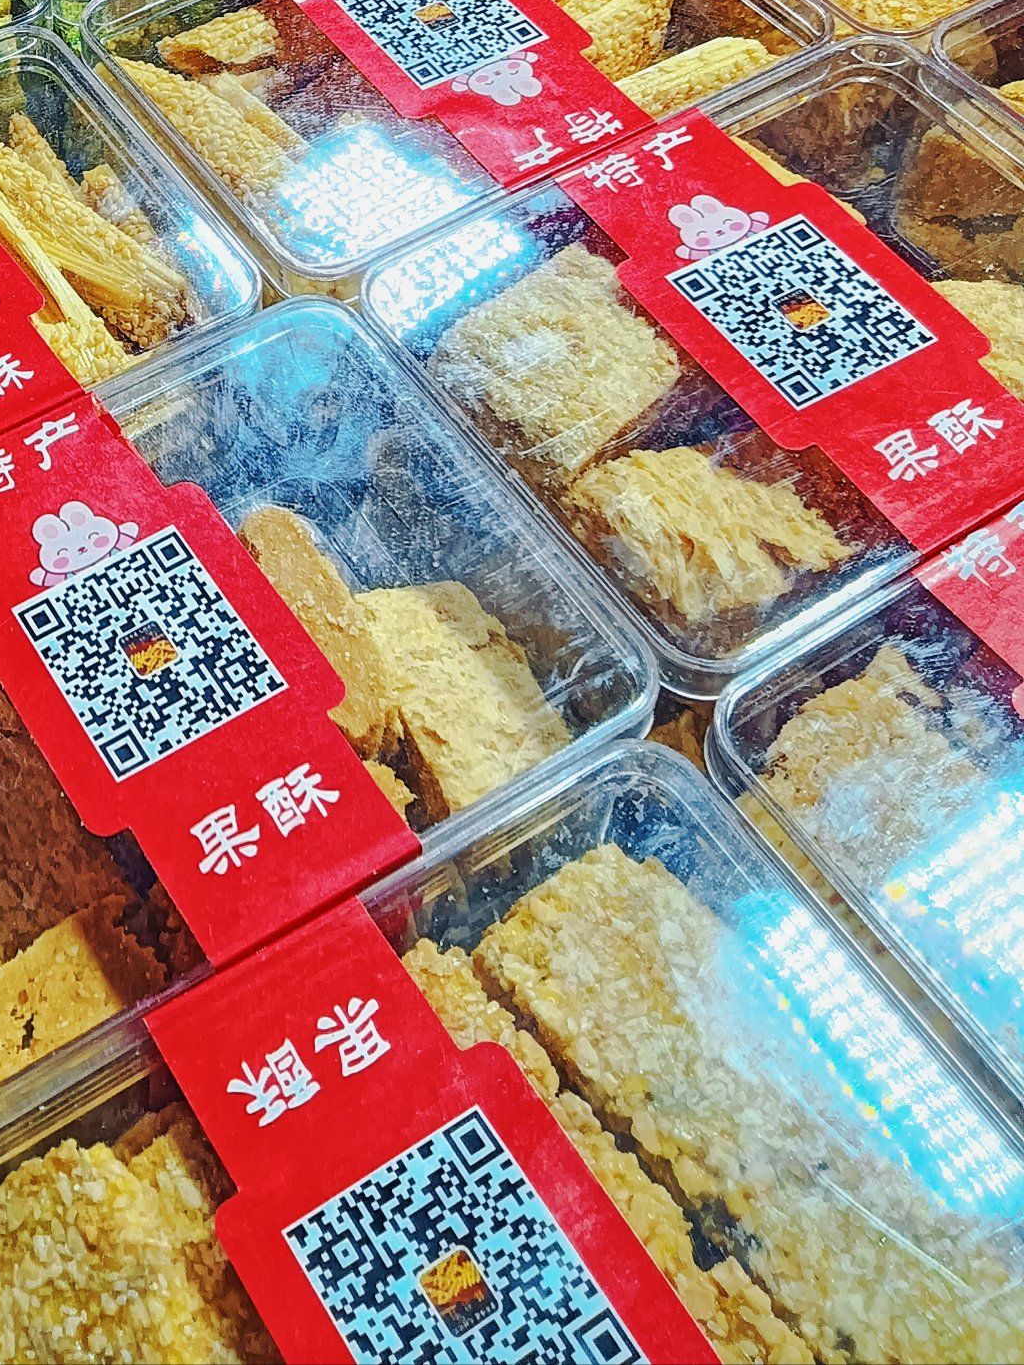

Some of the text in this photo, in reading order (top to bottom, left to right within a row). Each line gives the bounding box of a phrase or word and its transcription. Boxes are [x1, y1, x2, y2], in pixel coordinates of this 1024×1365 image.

[514, 106, 624, 172] 特产
[583, 126, 693, 193] 特产
[873, 398, 1004, 483] 果酥
[940, 498, 1024, 588] 特
[189, 762, 341, 876] 果酥
[226, 996, 391, 1127] 果酥
